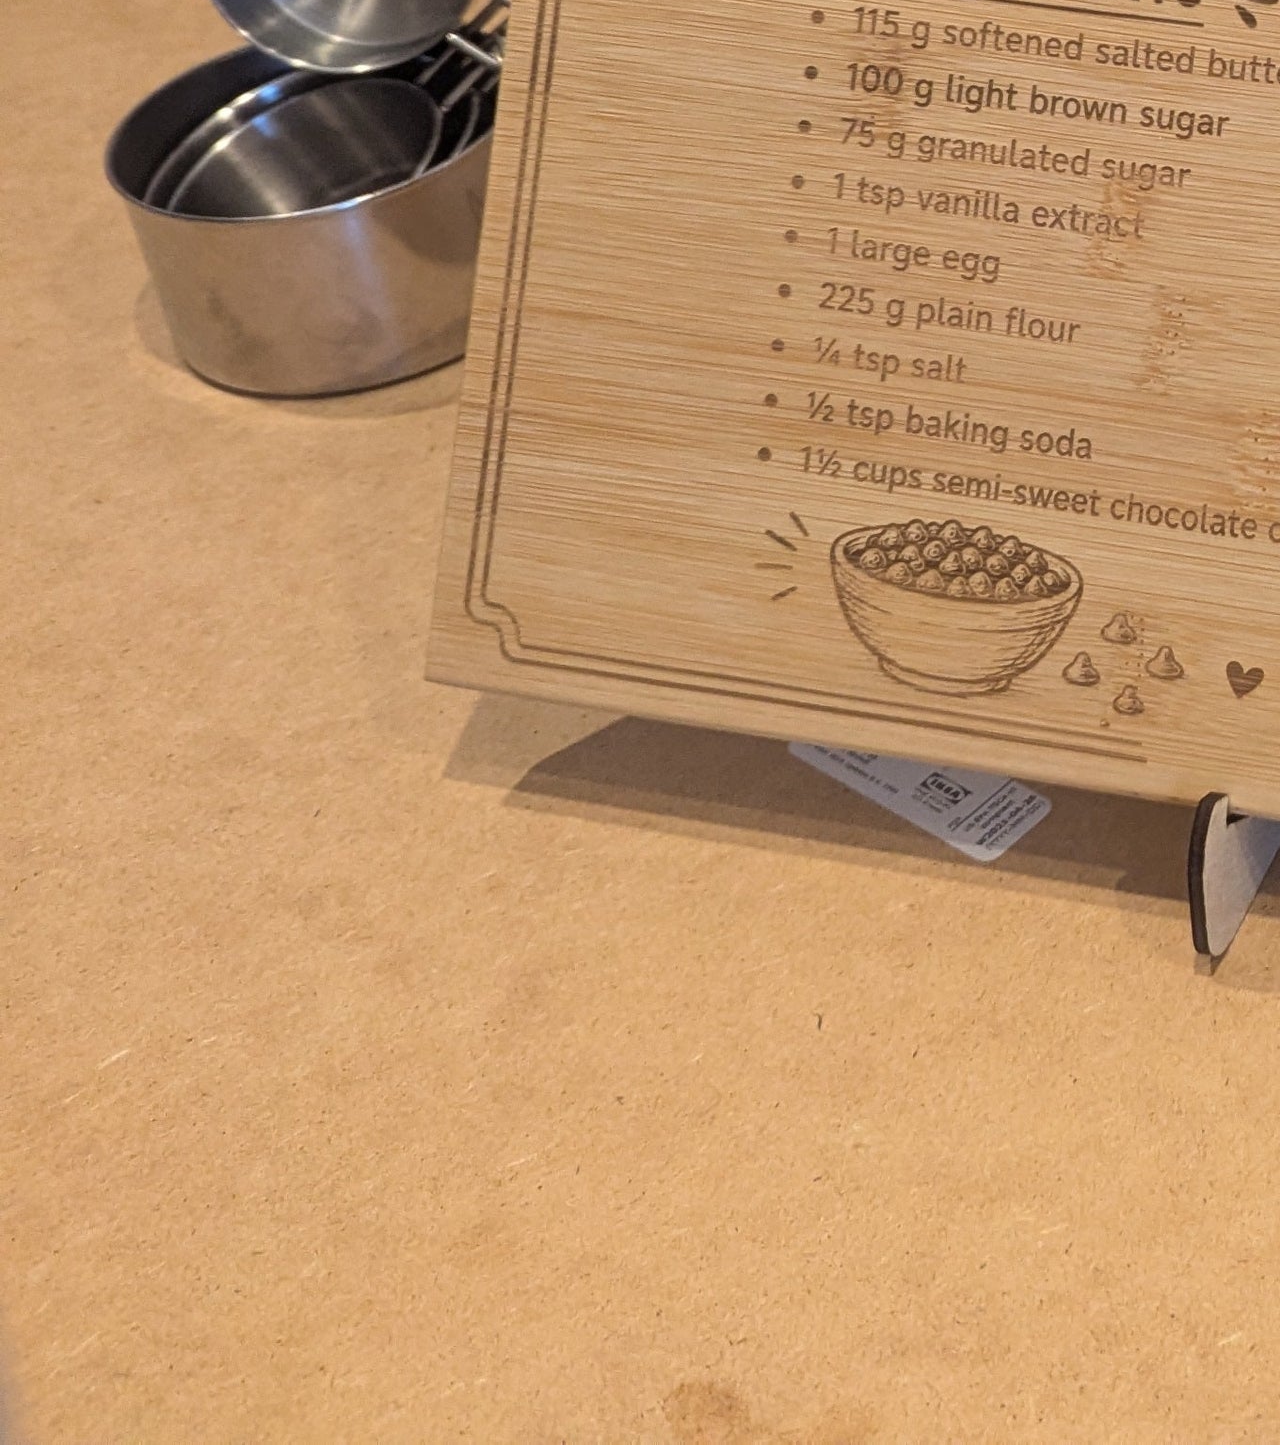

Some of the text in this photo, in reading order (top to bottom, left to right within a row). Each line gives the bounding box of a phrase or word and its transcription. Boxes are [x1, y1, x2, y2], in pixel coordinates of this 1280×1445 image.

[852, 7, 899, 38] 115
[911, 20, 931, 50] g
[942, 22, 1084, 61] softened
[1095, 38, 1196, 74] salted
[846, 63, 1230, 140] 100 g light brown sugar
[839, 119, 1192, 190] 75 g granulated sugar
[833, 173, 1146, 240] 1 tsp vanilla extract
[826, 228, 1001, 282] 1 large egg
[819, 283, 1081, 344] 225 g plain flour
[852, 344, 900, 381] tsp
[911, 352, 968, 383] salt
[806, 392, 1092, 460] ½ tsp baking soda
[852, 460, 922, 494] cups
[932, 470, 1101, 517] semi-sweet
[1109, 493, 1258, 540] chocolate
